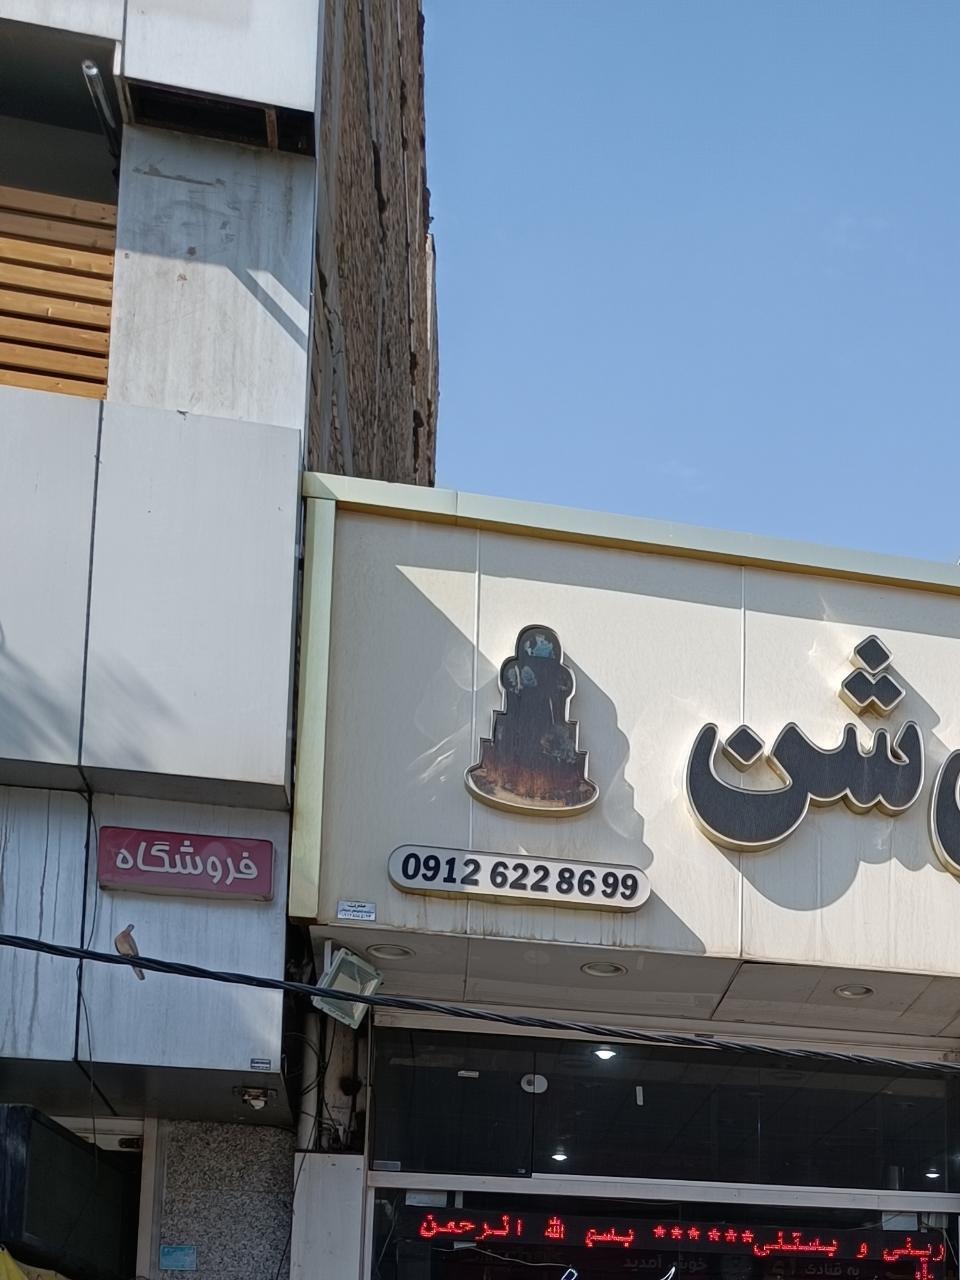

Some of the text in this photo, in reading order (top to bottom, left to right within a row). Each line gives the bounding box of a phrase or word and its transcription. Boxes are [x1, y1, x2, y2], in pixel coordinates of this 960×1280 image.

[686, 634, 926, 852] شن
[115, 840, 258, 885] فروشگاه
[419, 1214, 524, 1241] الرحمن
[584, 1227, 635, 1248] بسم
